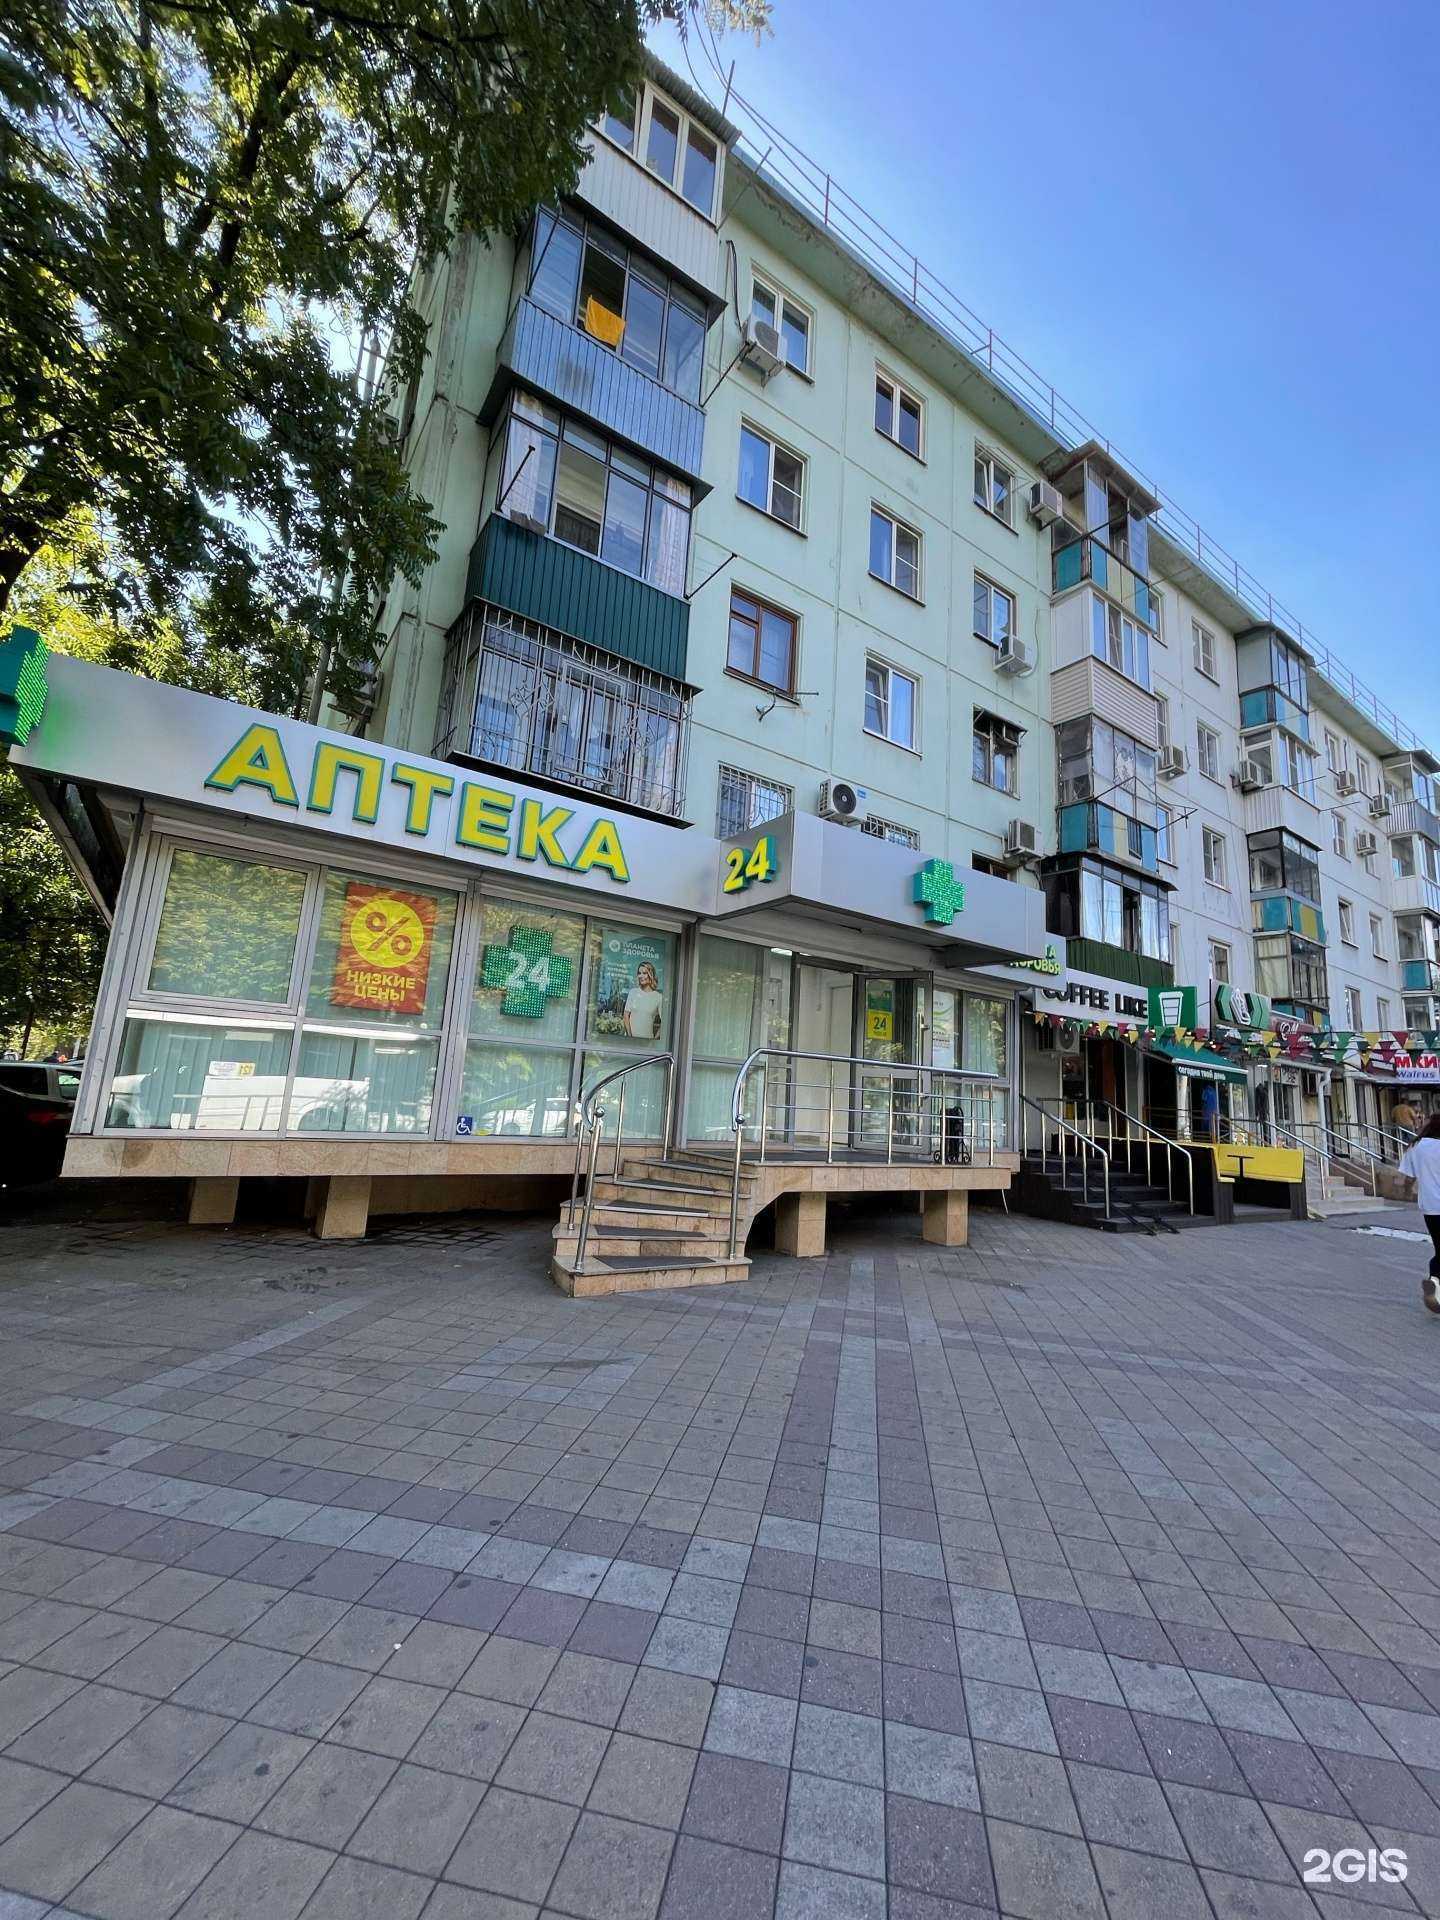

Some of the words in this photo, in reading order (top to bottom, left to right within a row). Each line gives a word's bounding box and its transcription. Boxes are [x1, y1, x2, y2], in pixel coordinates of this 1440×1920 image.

[204, 722, 630, 883] АПТЕКА
[723, 834, 776, 894] 24
[623, 942, 656, 953] ПЛАНЕТА
[346, 970, 417, 989] НИЗКИЕ
[505, 951, 550, 992] 24
[354, 984, 406, 1002] ЦЕНЫ
[1114, 993, 1149, 1019] LIKE
[873, 1016, 887, 1031] 24
[1397, 1070, 1435, 1079] Walrus
